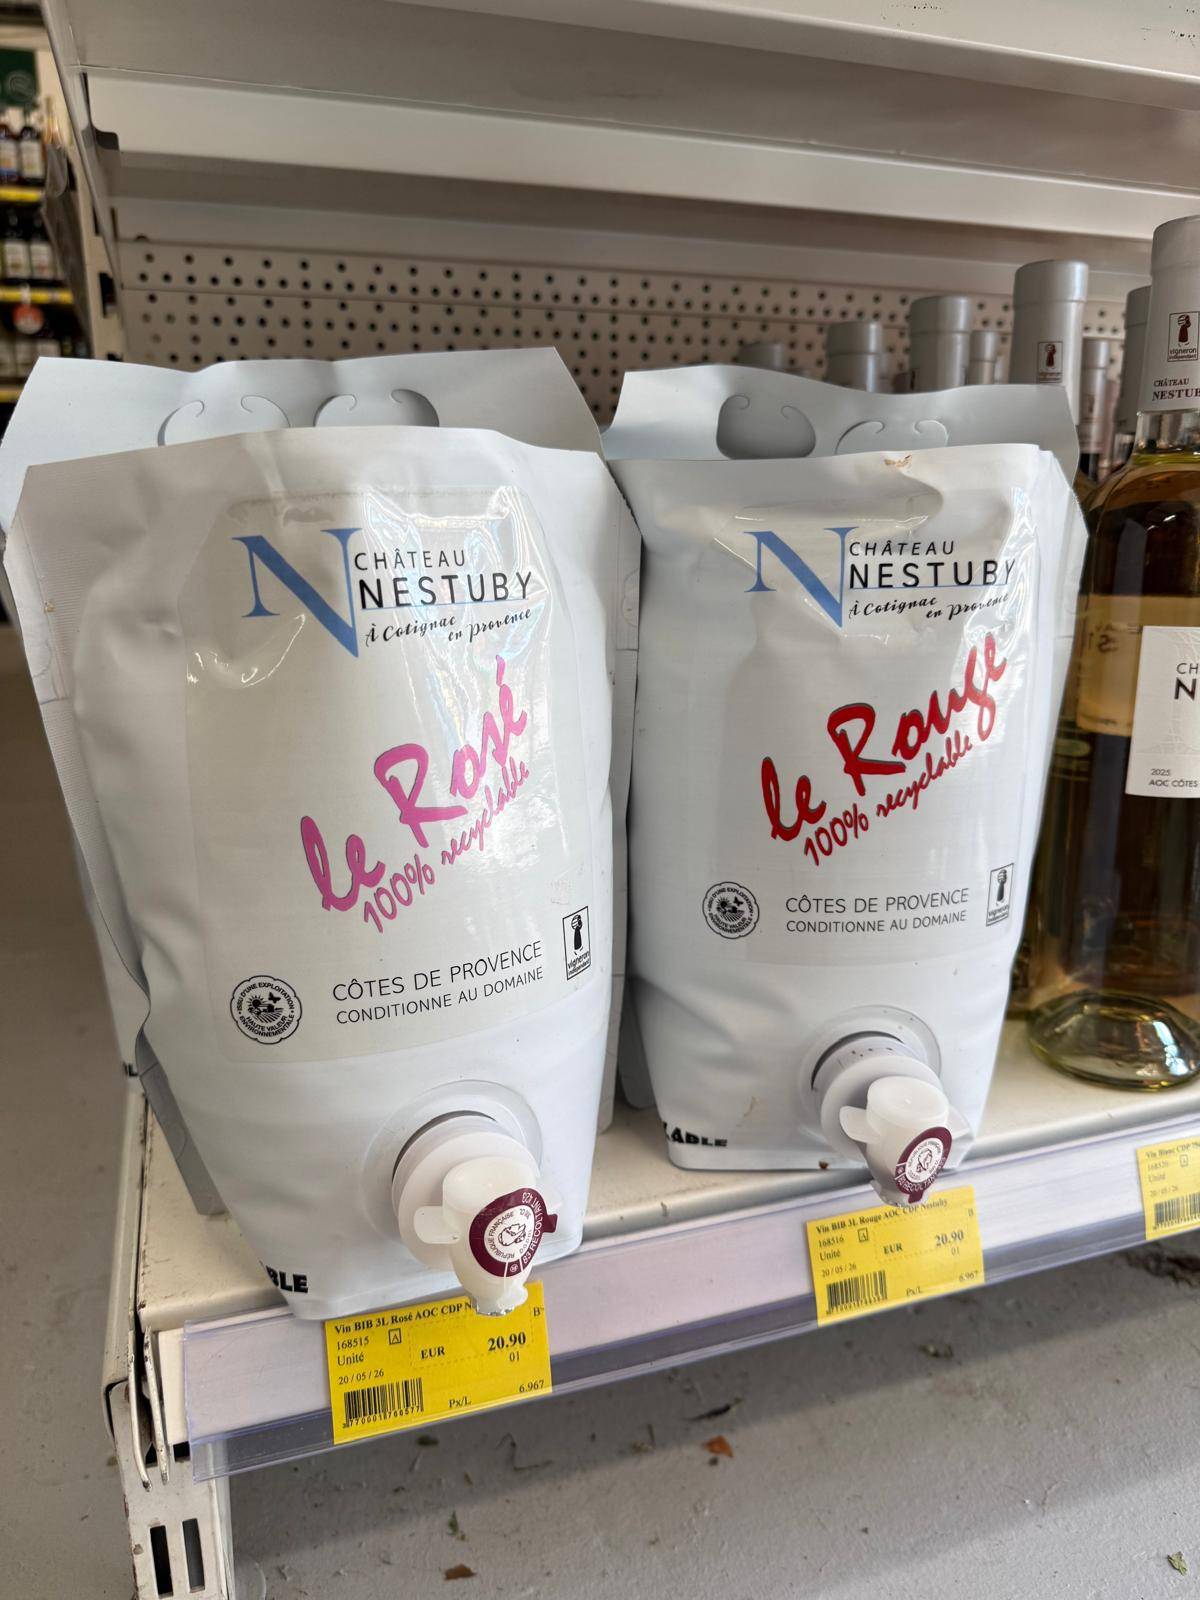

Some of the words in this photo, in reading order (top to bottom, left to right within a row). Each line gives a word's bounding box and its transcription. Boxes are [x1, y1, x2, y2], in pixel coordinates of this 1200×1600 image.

[1153, 378, 1190, 388] CHÂTEAU
[354, 548, 466, 571] CHÂTEAU
[849, 540, 956, 557] CHÂTEAU
[743, 526, 860, 629] N
[850, 558, 1017, 589] NESTUBY
[231, 527, 364, 658] N
[359, 571, 533, 609] NESTUBY
[863, 597, 938, 617] Cotignac
[925, 608, 943, 619] en
[382, 615, 457, 643] Cotignac
[448, 630, 464, 643] en
[761, 756, 828, 842] le
[827, 631, 1008, 797] Rouge
[300, 815, 386, 912] le
[374, 654, 528, 849] Rosé
[1148, 779, 1169, 788] AOC
[1171, 778, 1199, 788] CÔTES
[804, 803, 869, 867] 100%
[876, 730, 973, 818] recyclable
[364, 854, 436, 934] 100%
[441, 756, 530, 865] recyclable
[785, 893, 847, 914] CÔTES
[854, 897, 879, 913] DE
[885, 887, 970, 912] PROVENCE
[786, 919, 886, 934] CONDITIONNE
[890, 918, 908, 931] AU
[912, 909, 968, 929] DOMAINE
[332, 975, 405, 1002] CÔTES
[414, 969, 443, 991] DE
[450, 940, 543, 984] PROVENCE
[336, 993, 452, 1025] CONDITIONNE
[458, 987, 478, 1005] AU
[483, 966, 544, 998] DOMAINE
[816, 1224, 830, 1235] Vin
[831, 1221, 846, 1232] BIB
[847, 1219, 858, 1229] 3L
[859, 1214, 882, 1227] Rouge
[883, 1209, 901, 1220] AOC
[883, 1243, 903, 1255] EUR
[934, 1229, 965, 1247] 20.90
[334, 1324, 351, 1335] Vin
[354, 1319, 374, 1332] BIB
[375, 1316, 389, 1328] 3L
[391, 1312, 413, 1326] Rosé
[414, 1308, 439, 1321] AOC
[440, 1304, 463, 1315] CDP
[336, 1336, 370, 1351] 168515
[487, 1331, 527, 1352] 20.90
[337, 1353, 365, 1367] Unité
[420, 1346, 446, 1360] EUR
[508, 1351, 521, 1363] 01
[448, 1395, 472, 1409] Px/L
[519, 1380, 546, 1393] 6.967
